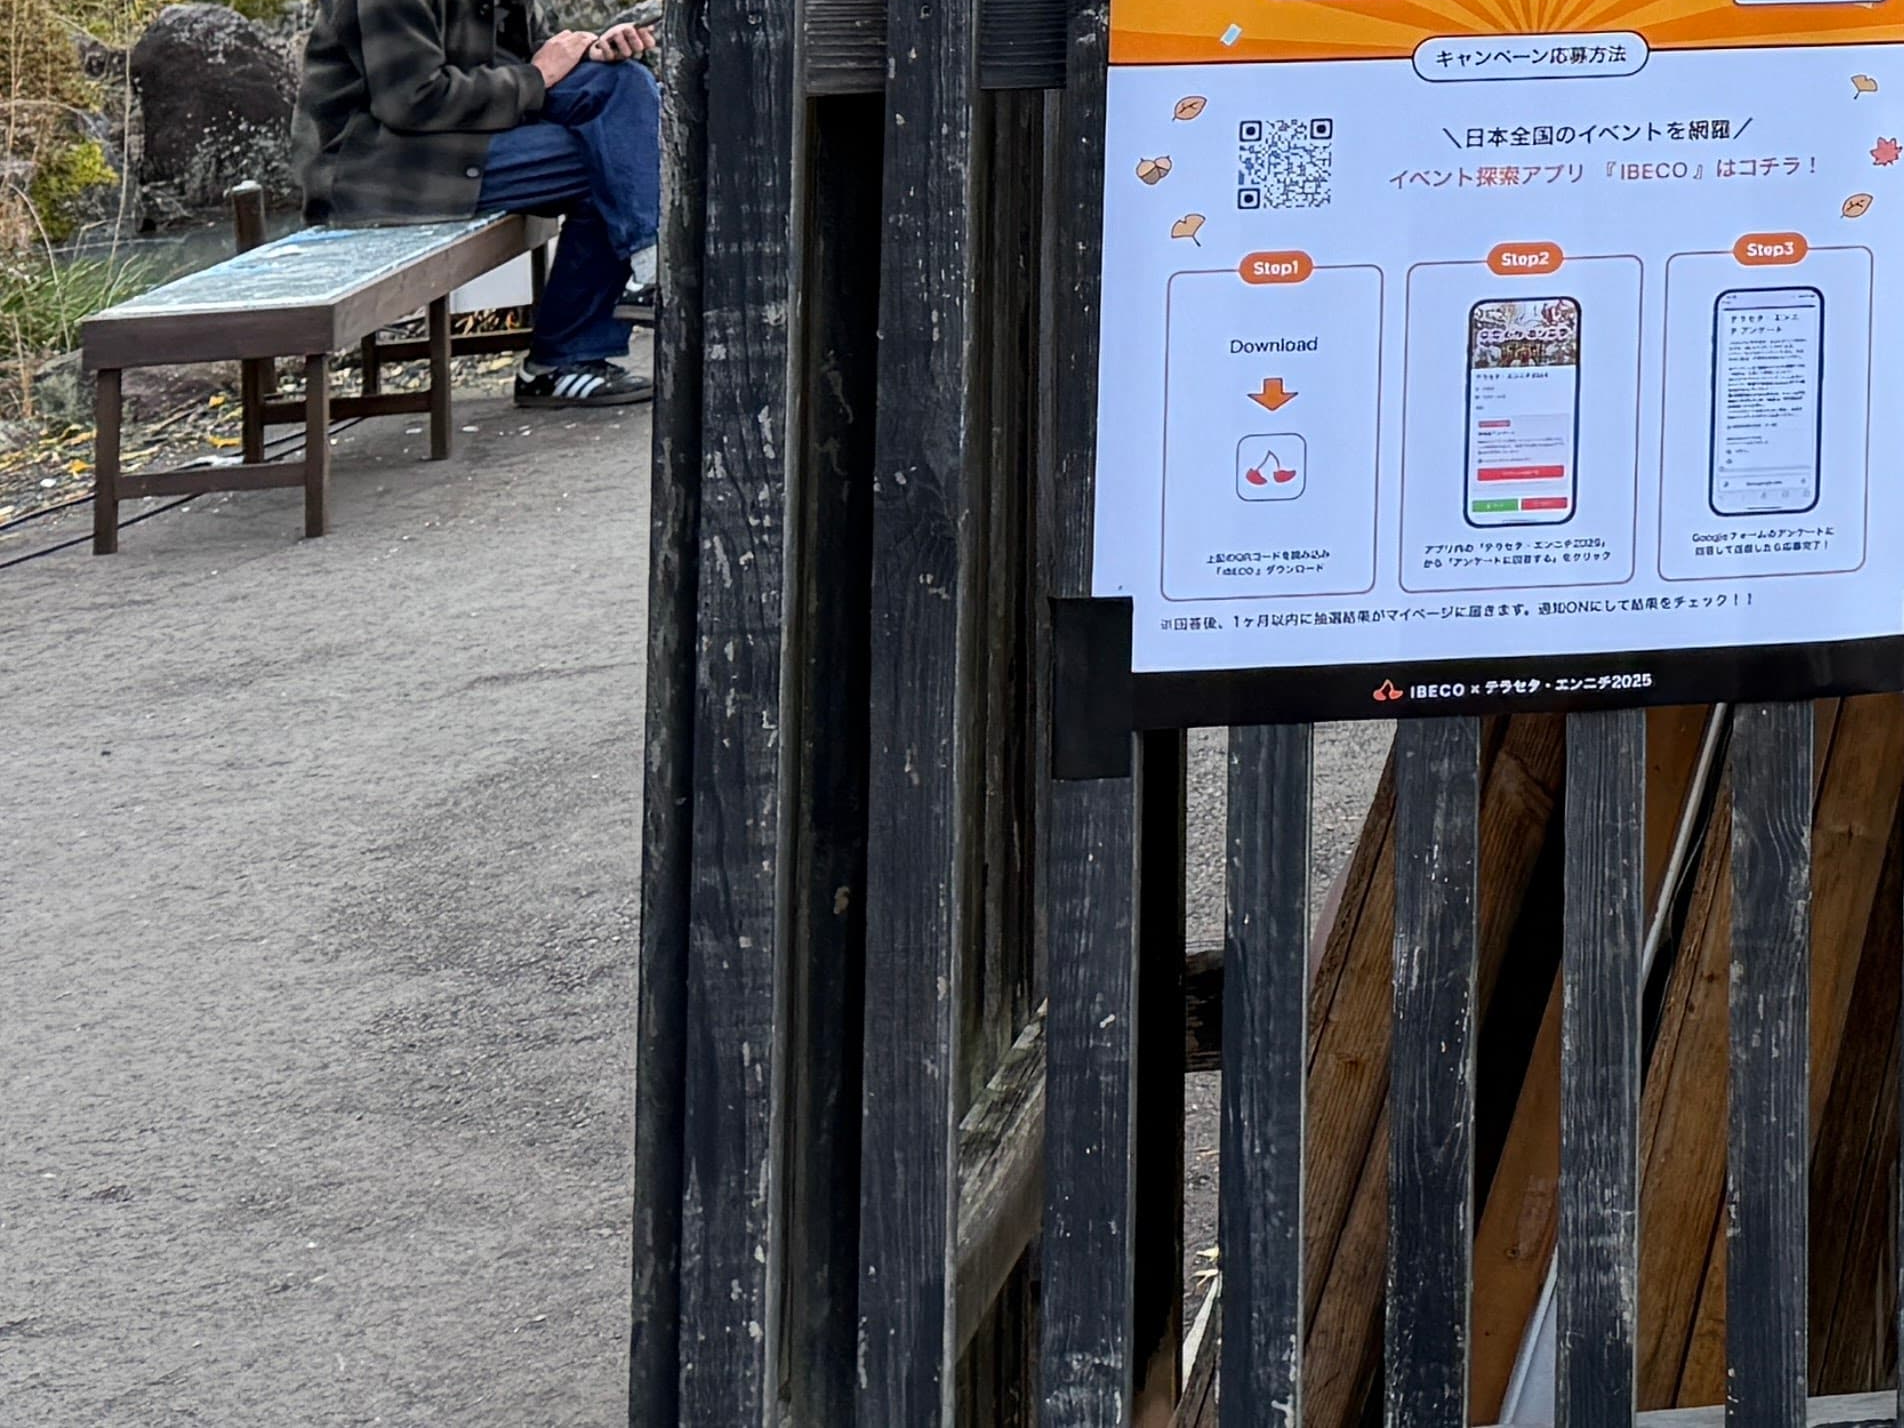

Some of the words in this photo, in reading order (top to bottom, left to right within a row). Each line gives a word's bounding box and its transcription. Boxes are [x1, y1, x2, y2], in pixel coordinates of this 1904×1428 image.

[1435, 45, 1627, 68] キャンペーン応募方法
[1500, 249, 1549, 271] Step2
[1746, 240, 1795, 262] Step3
[1253, 259, 1299, 278] Step1
[1230, 335, 1318, 355] Download
[1410, 683, 1465, 699] IBECO
[1485, 673, 1653, 695] テラセタ・エンニチ2025
